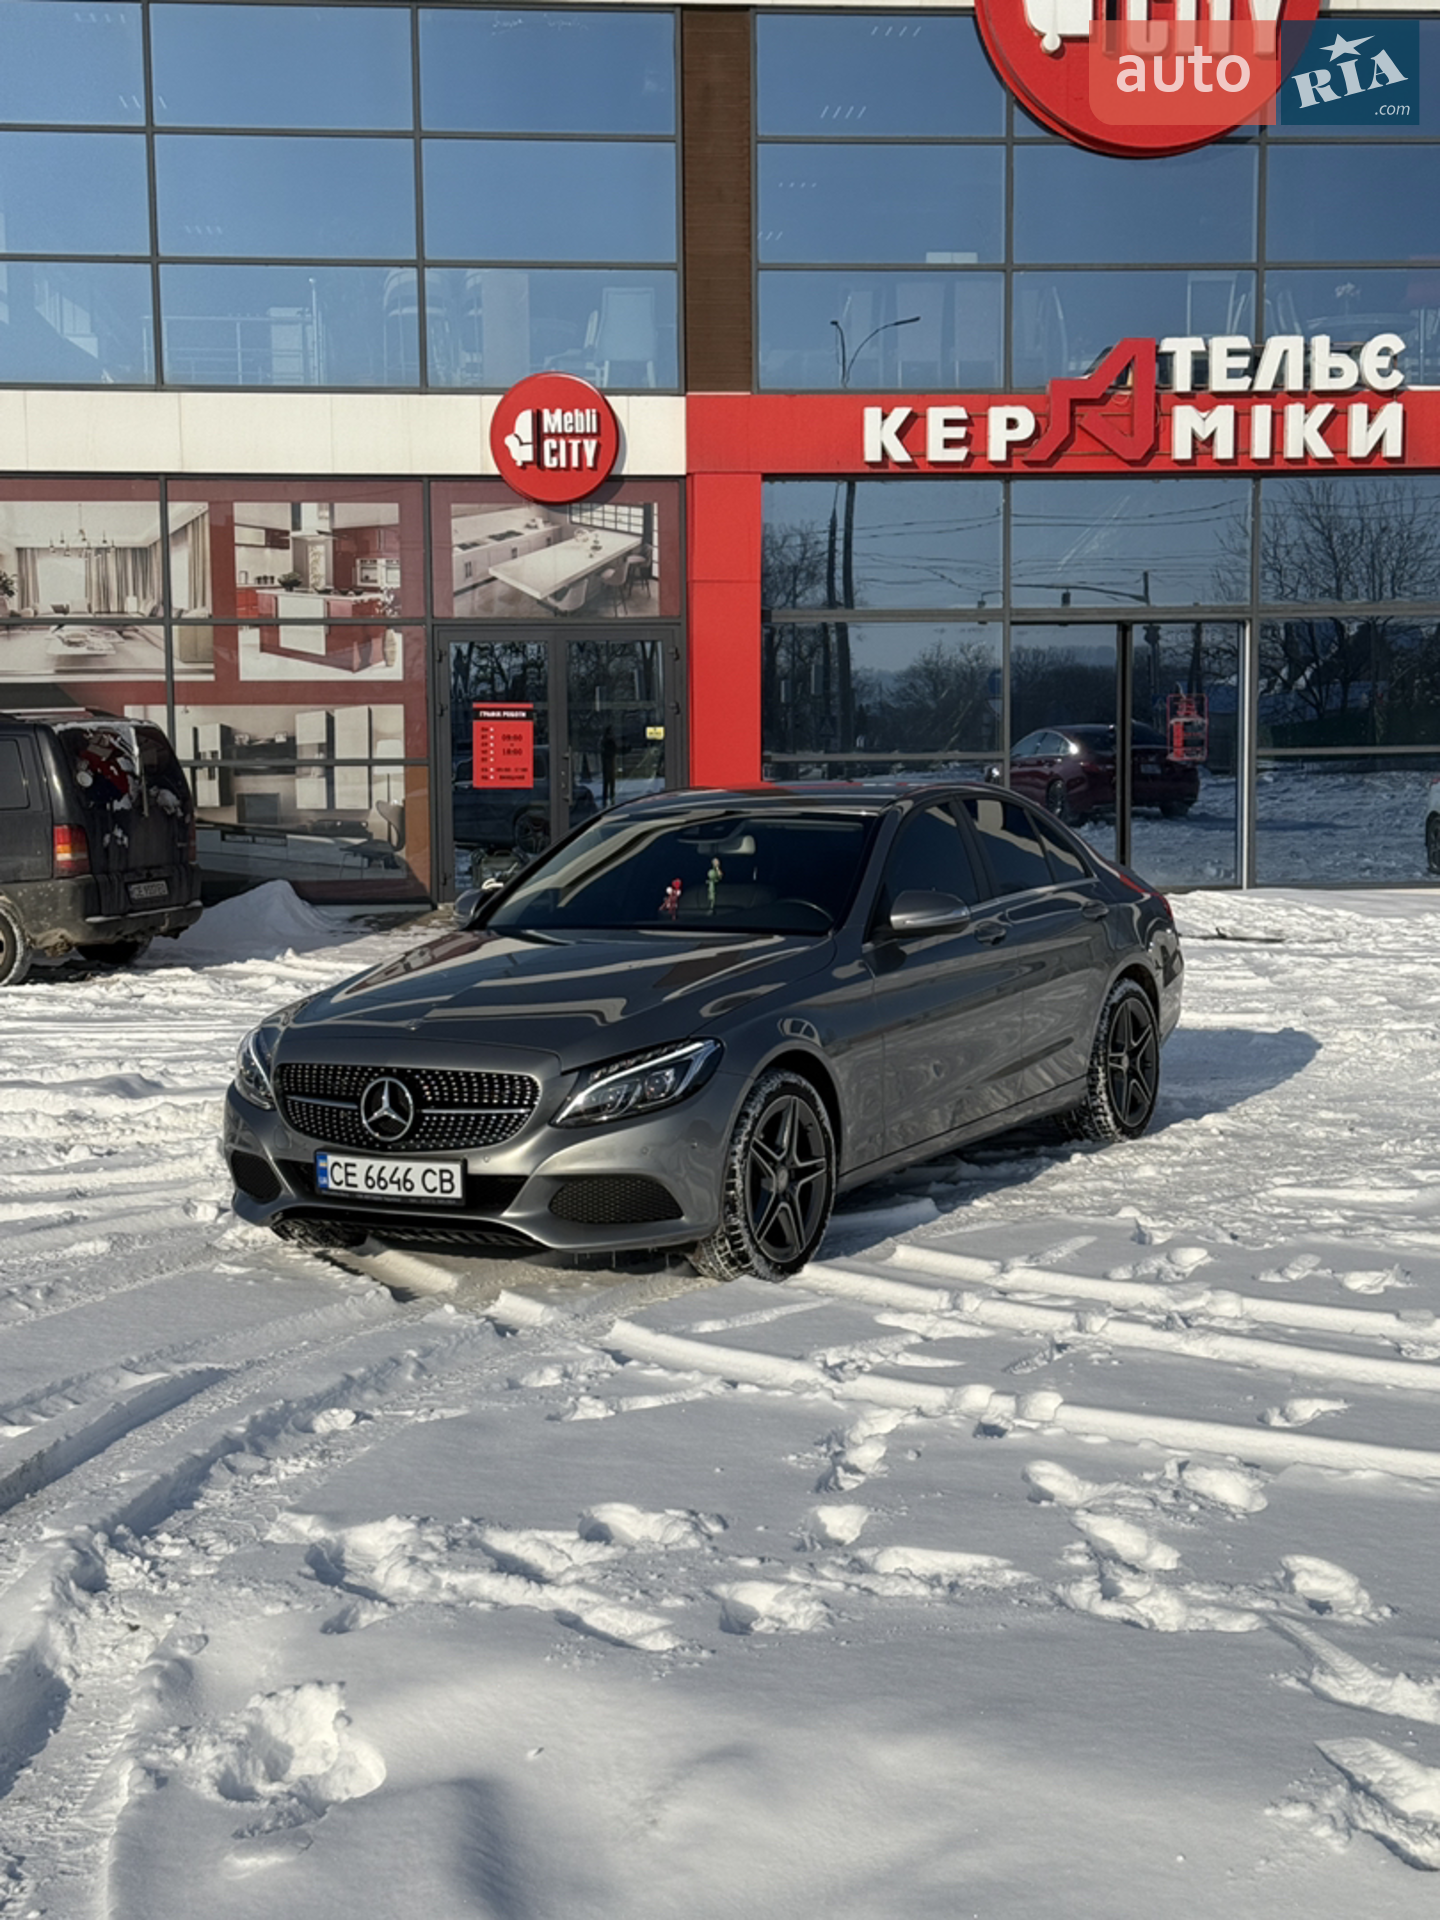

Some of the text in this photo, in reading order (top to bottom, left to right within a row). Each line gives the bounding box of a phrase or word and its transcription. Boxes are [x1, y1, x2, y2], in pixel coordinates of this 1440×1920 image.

[543, 408, 598, 434] Mebli
[543, 439, 598, 468] CITY
[330, 1162, 456, 1195] CE 6646 CB
